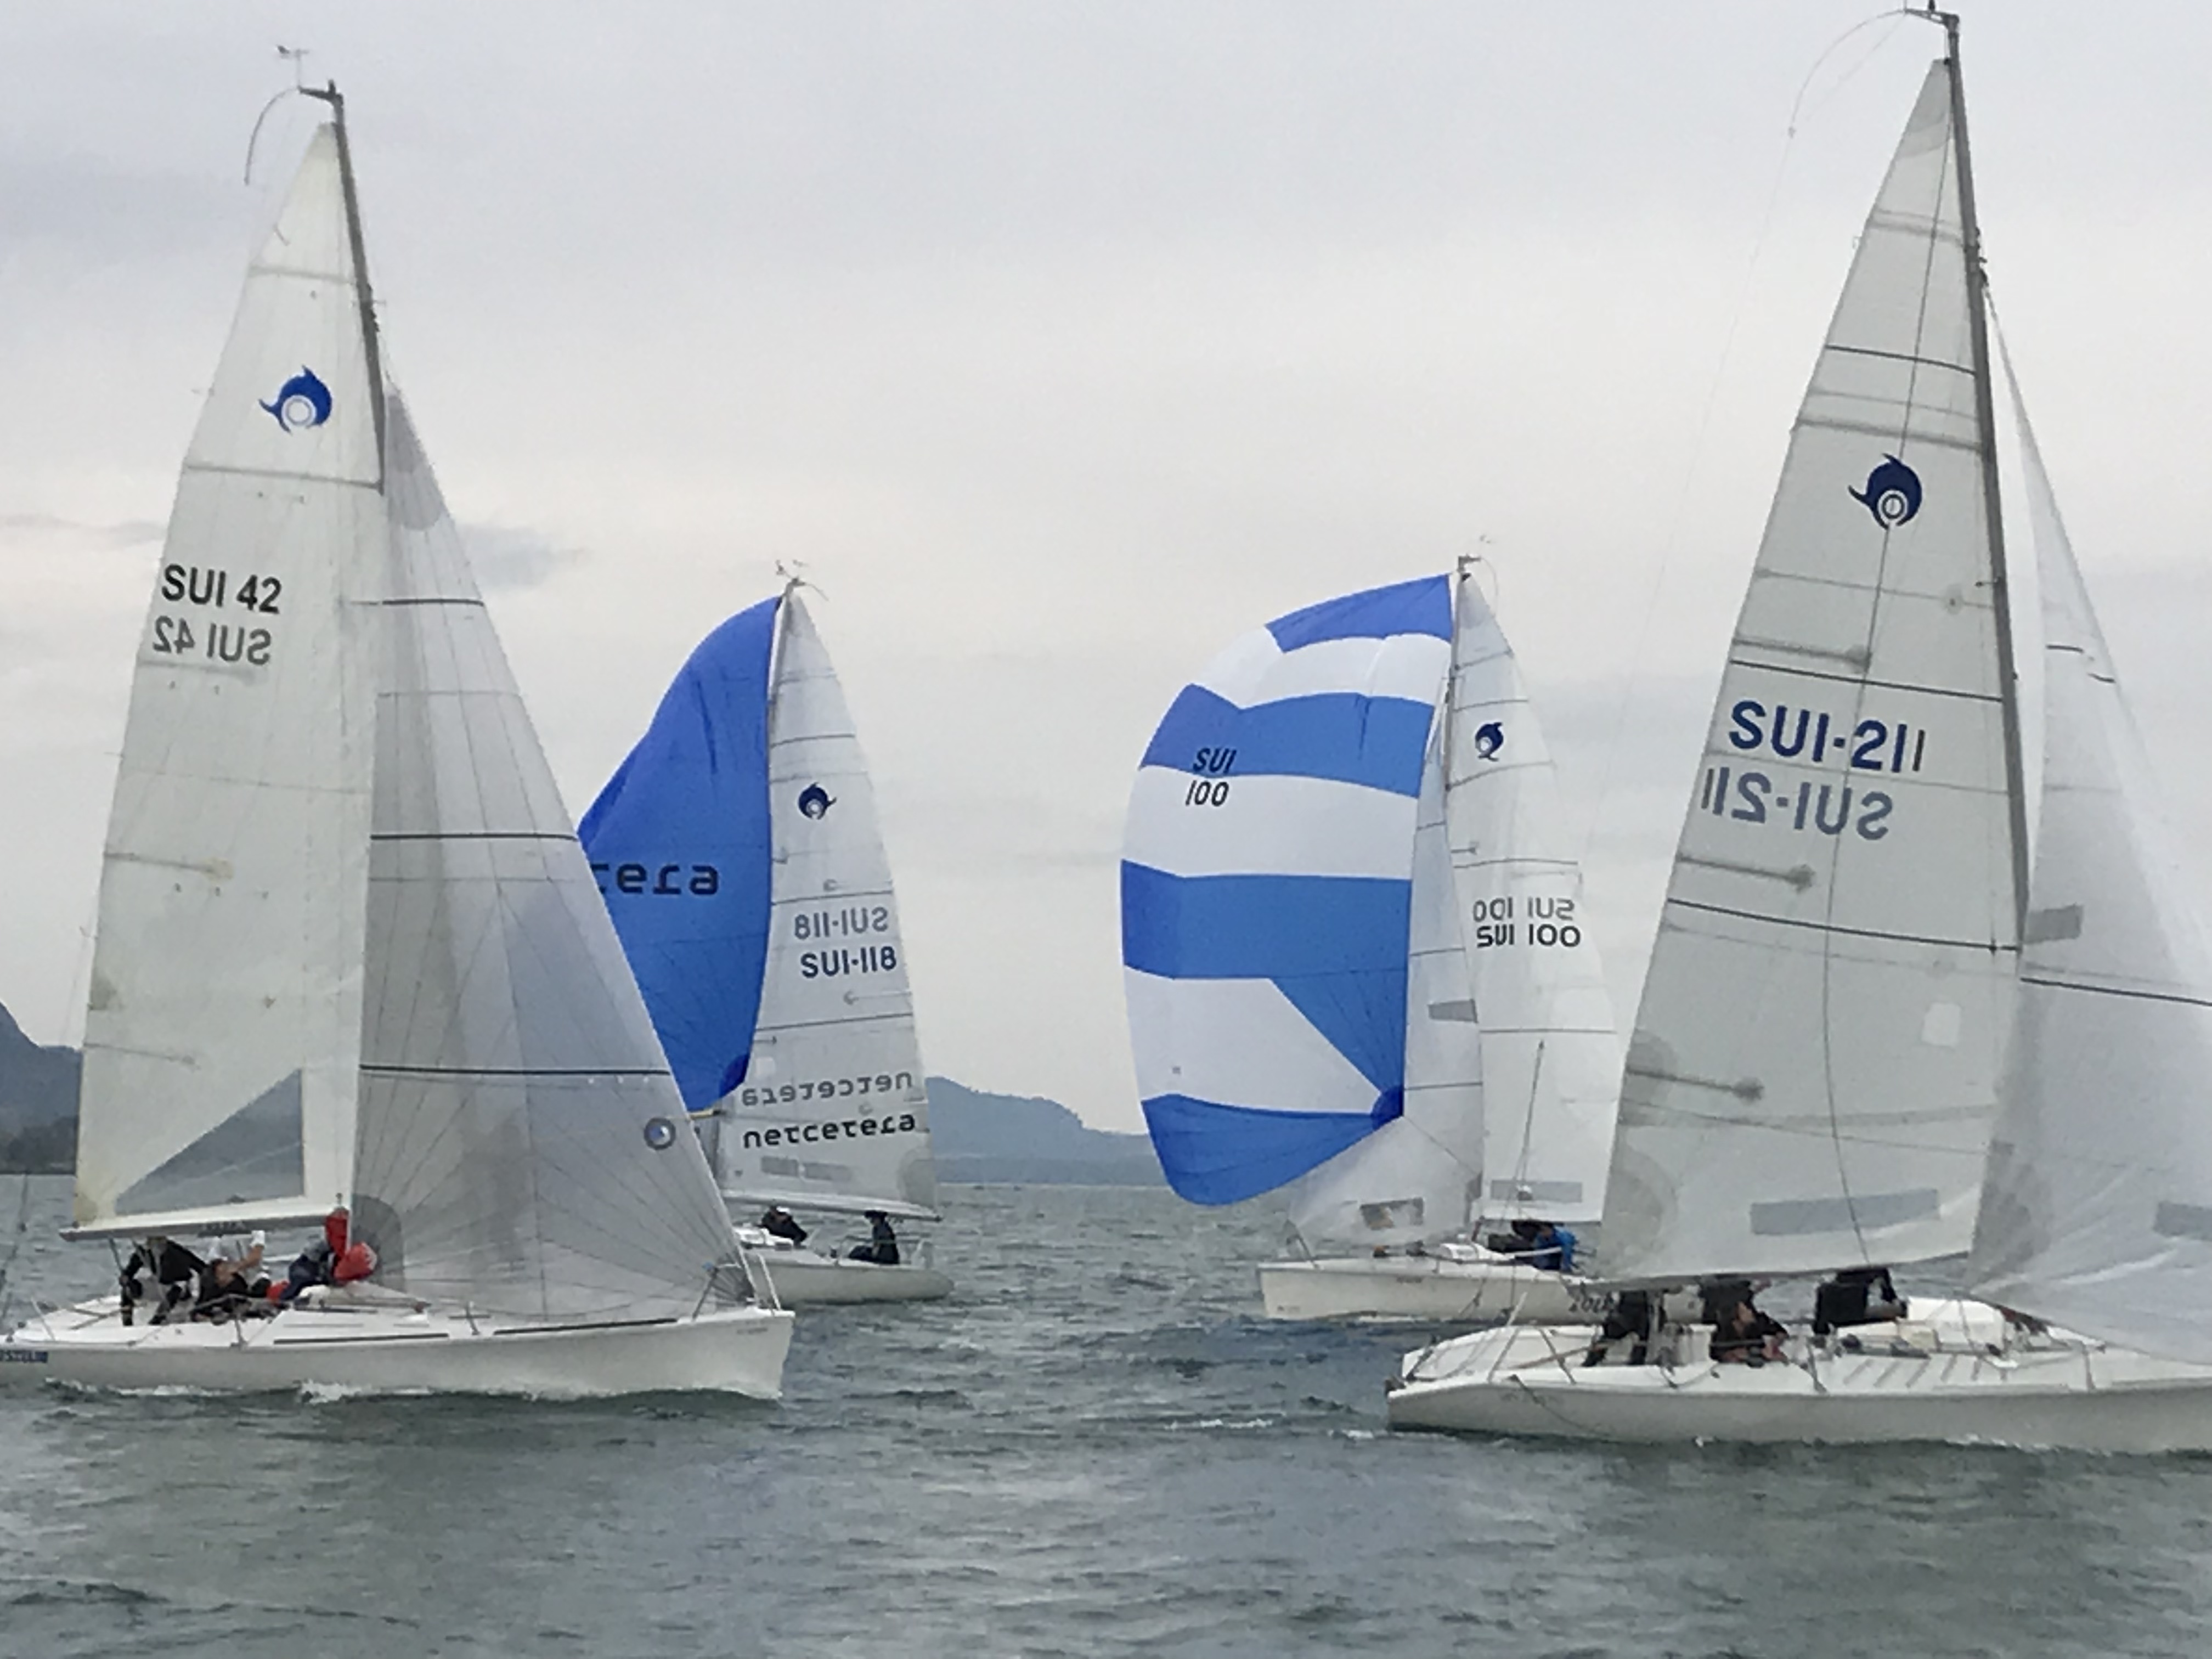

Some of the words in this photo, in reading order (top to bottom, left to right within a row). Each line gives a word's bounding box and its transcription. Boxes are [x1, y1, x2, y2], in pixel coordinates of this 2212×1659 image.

[161, 563, 226, 607] SUI
[236, 574, 282, 614] 42
[1192, 747, 1237, 774] SUI
[1185, 780, 1229, 807] 100
[1476, 924, 1514, 948] SUI
[1528, 924, 1581, 947] 100
[743, 1113, 916, 1149] netcetera
